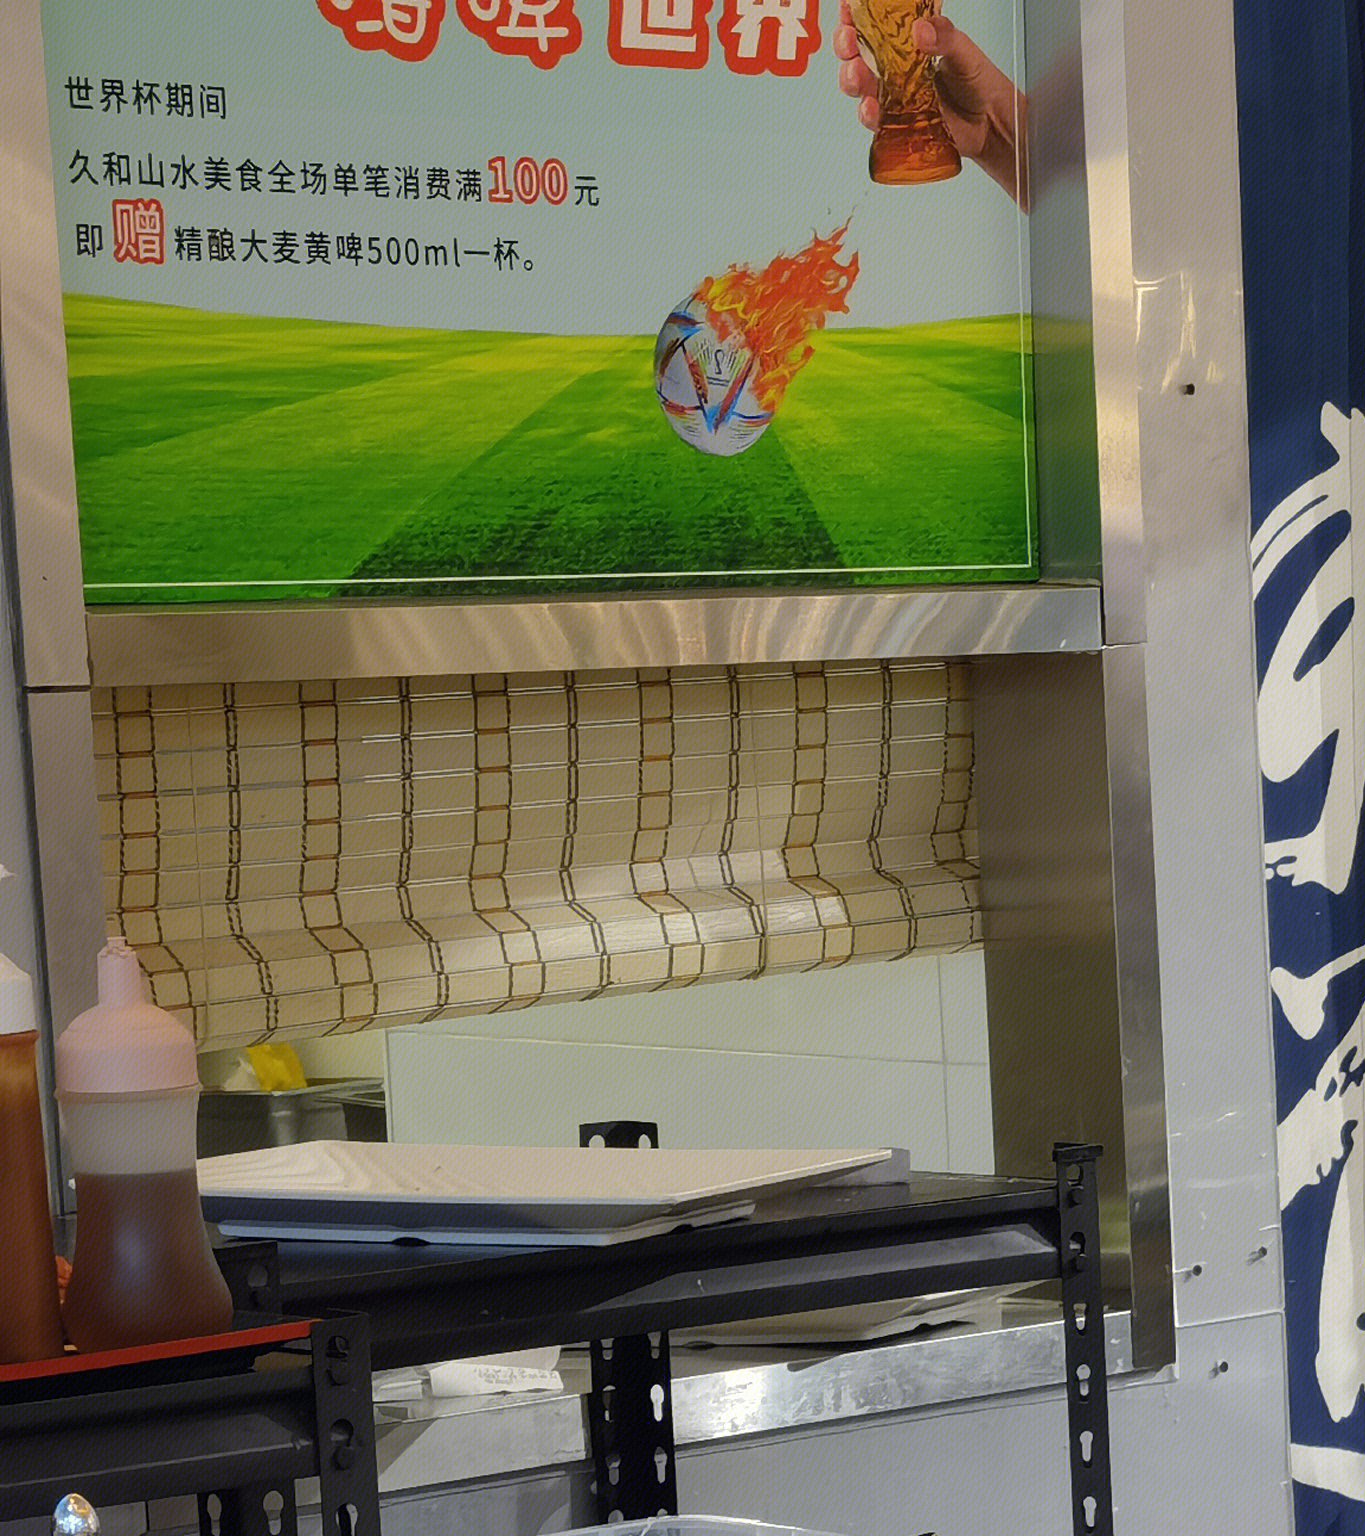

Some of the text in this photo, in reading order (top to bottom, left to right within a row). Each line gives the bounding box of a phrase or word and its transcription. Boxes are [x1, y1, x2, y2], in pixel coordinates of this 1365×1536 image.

[64, 76, 227, 119] 世界杯期间
